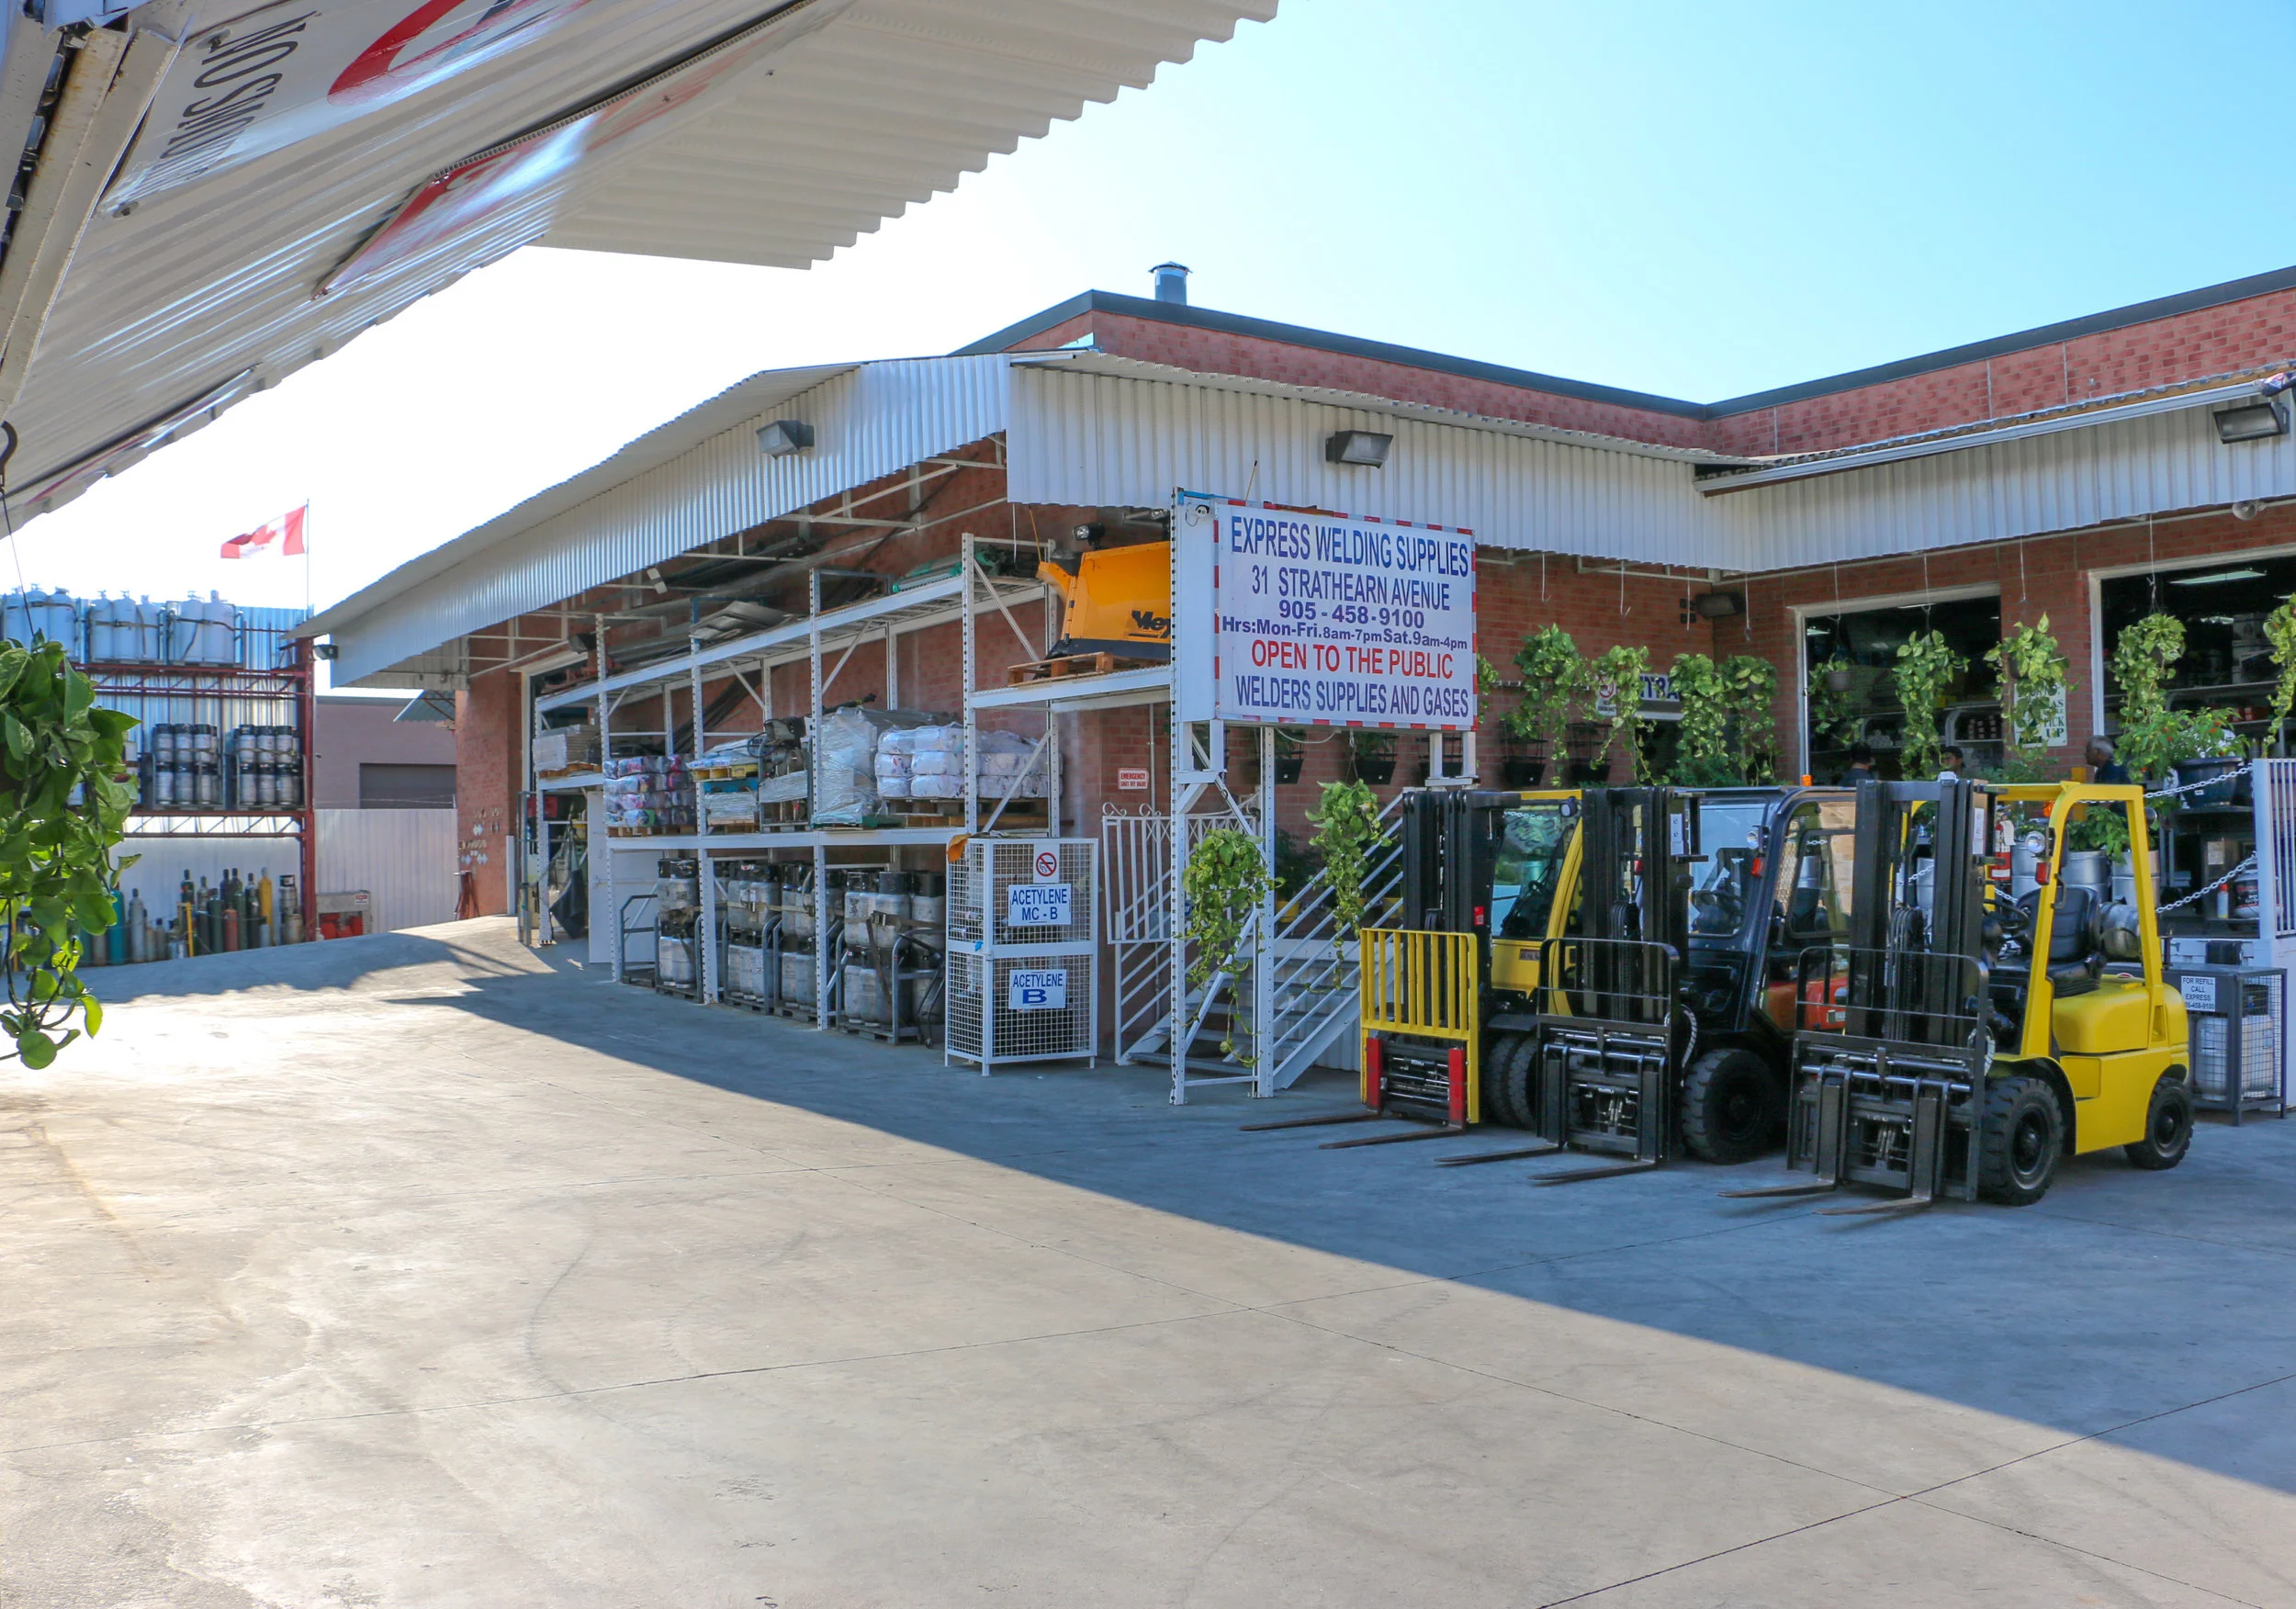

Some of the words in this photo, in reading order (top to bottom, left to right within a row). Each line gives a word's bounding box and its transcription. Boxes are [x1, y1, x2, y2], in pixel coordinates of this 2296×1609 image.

[193, 9, 318, 89] NO
[1232, 515, 1311, 559] EXPRESS
[1315, 524, 1391, 568] WELDING
[1396, 535, 1469, 577] SUPPLIES
[1252, 565, 1267, 594] 31
[1278, 567, 1387, 604] STRATHEARN
[1391, 578, 1450, 611] AVENUE
[1252, 639, 1307, 670] OPEN
[1312, 644, 1340, 672] TO
[1345, 646, 1383, 674] THE
[1390, 648, 1453, 679] PUBLIC
[1235, 675, 1311, 710] WELDERS
[1316, 681, 1387, 714] SUPPLIES
[1390, 685, 1420, 714] AND
[1424, 686, 1469, 717] GASES
[1011, 888, 1067, 906] ACETYLENE
[1021, 906, 1040, 920] MC
[1050, 906, 1058, 919] B
[1012, 973, 1063, 988] ACETYLENE
[1022, 988, 1047, 1004] B
